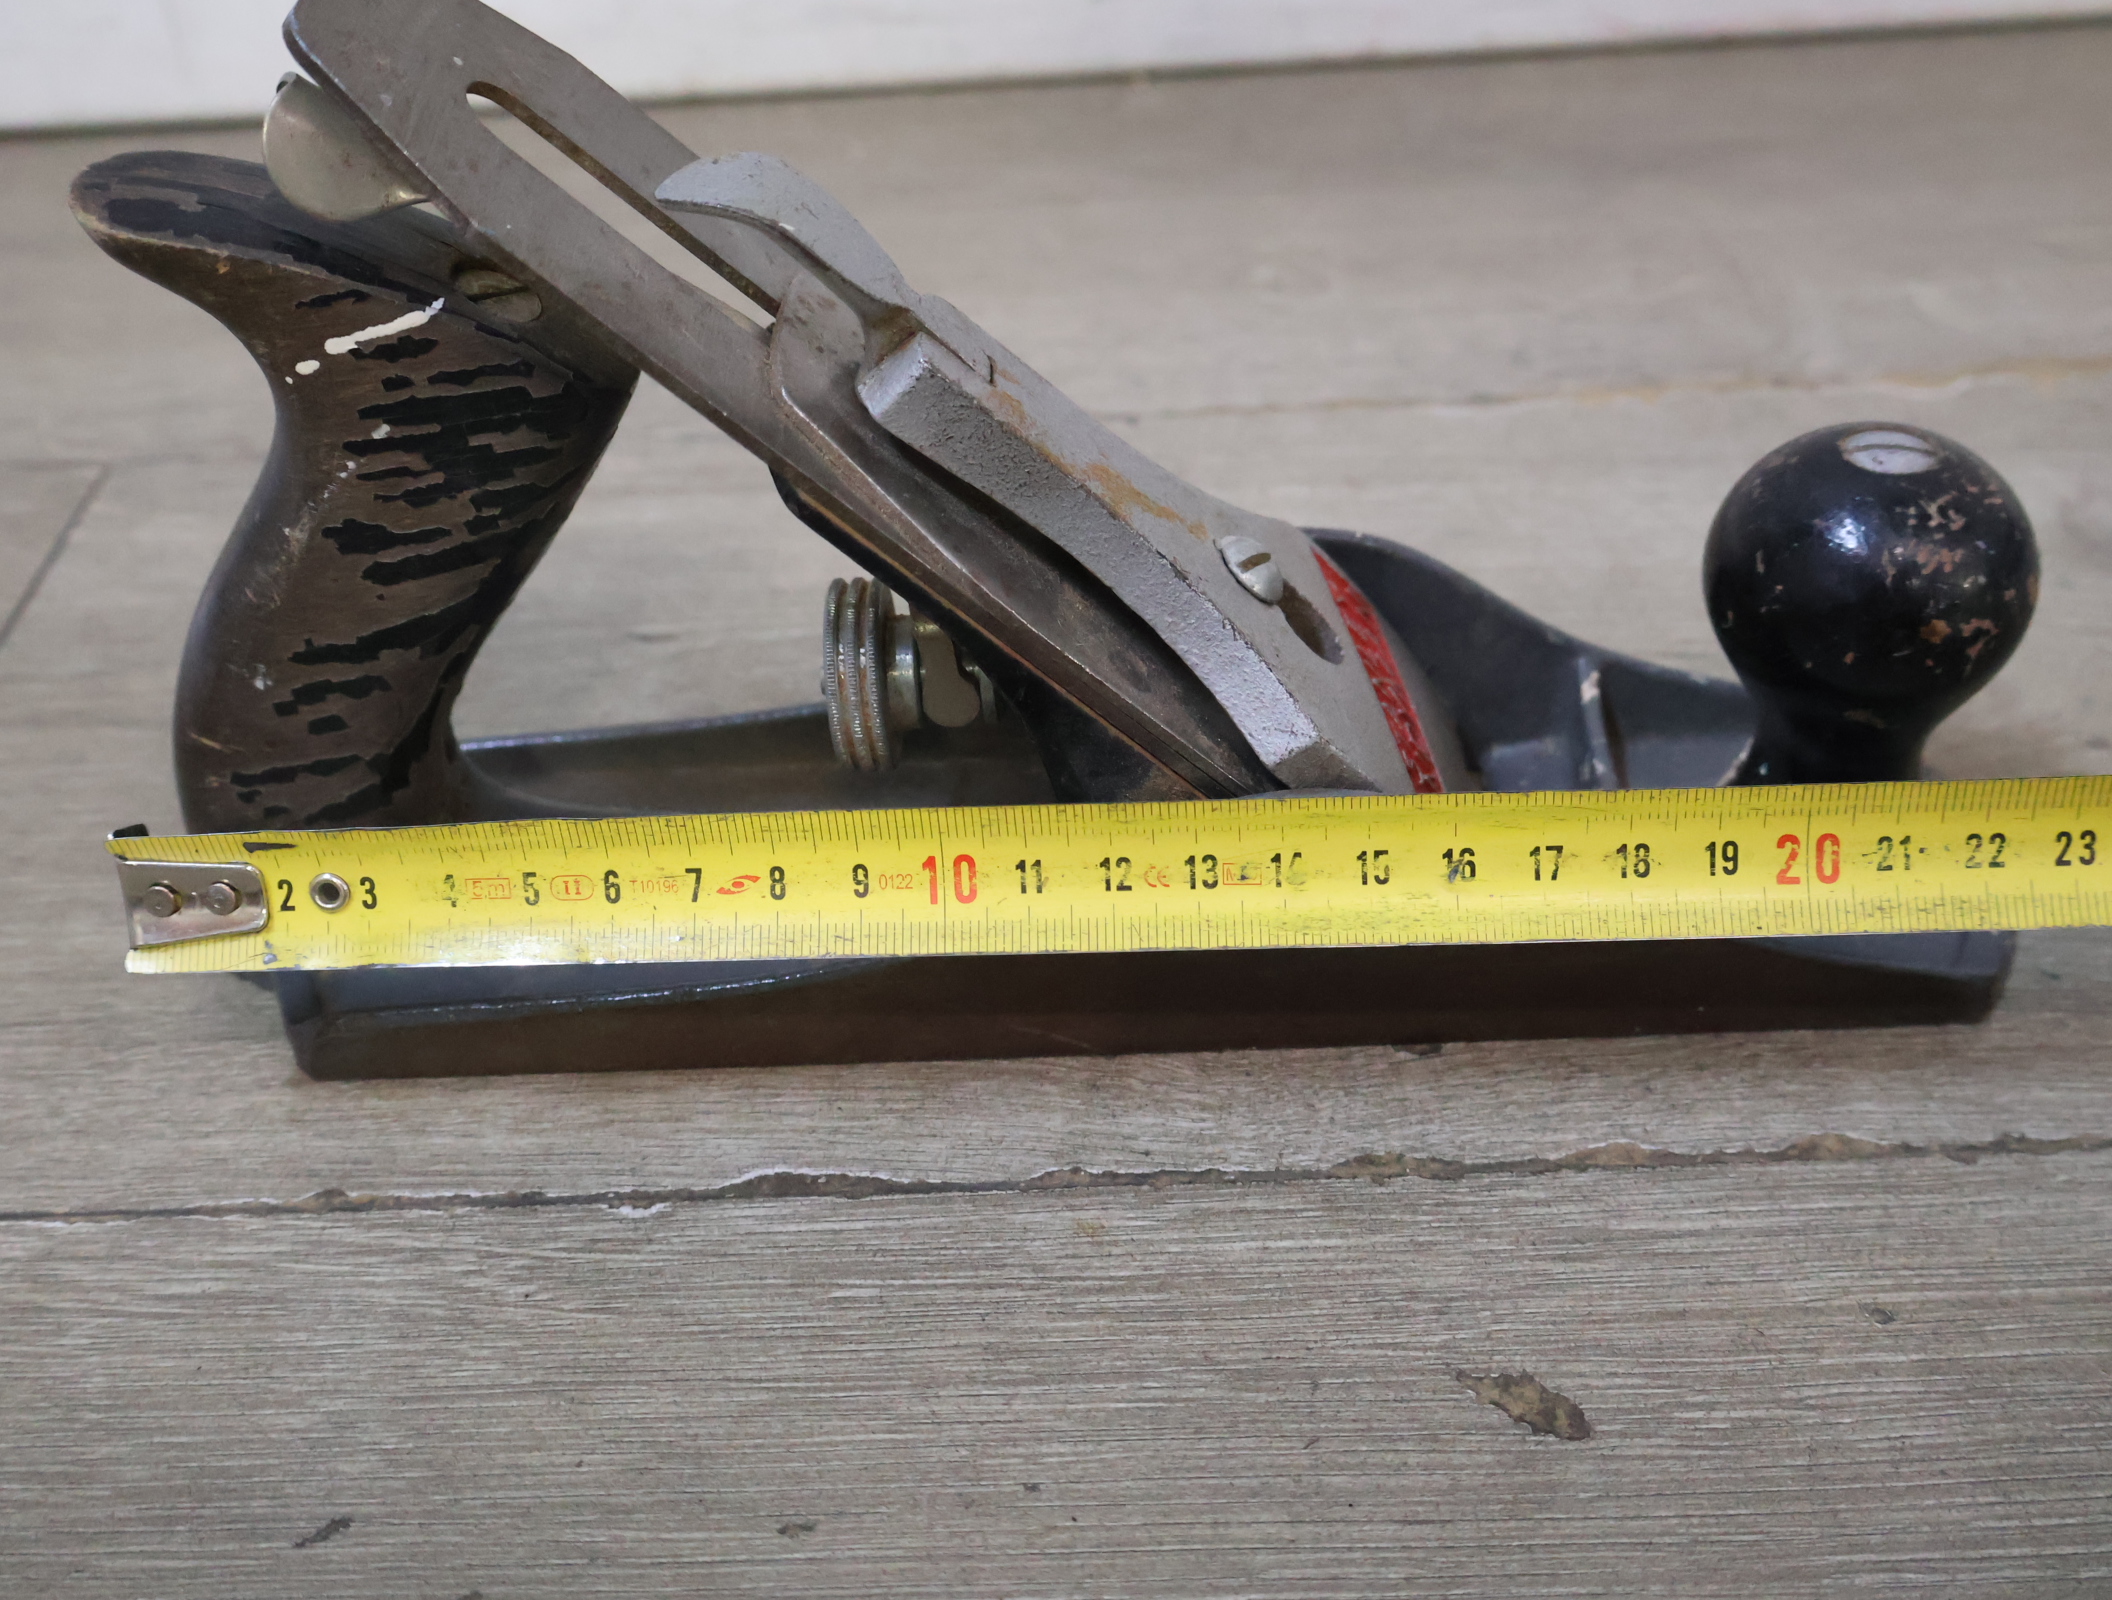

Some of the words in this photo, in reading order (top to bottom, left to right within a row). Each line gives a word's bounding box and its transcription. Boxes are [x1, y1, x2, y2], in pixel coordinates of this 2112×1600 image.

[277, 879, 296, 912] 2
[360, 876, 378, 910] 3
[471, 880, 506, 898] 5m
[522, 871, 540, 906] 5
[603, 869, 622, 904] 6
[684, 867, 703, 903] 7
[769, 865, 787, 901] 8
[851, 863, 870, 899] 9
[878, 873, 914, 890] 0122
[921, 853, 978, 906] 10
[1015, 859, 1043, 894] 11
[1099, 856, 1133, 892] 12
[1184, 853, 1219, 890] 13
[1356, 849, 1390, 886] 15
[1442, 847, 1477, 883] 16
[1529, 844, 1564, 882] 17
[1615, 842, 1651, 879] 18
[1704, 839, 1739, 876] 19
[1775, 832, 1841, 886] 20
[1875, 834, 1912, 872] 21
[1965, 832, 2007, 869] 22
[2054, 829, 2097, 867] 23
